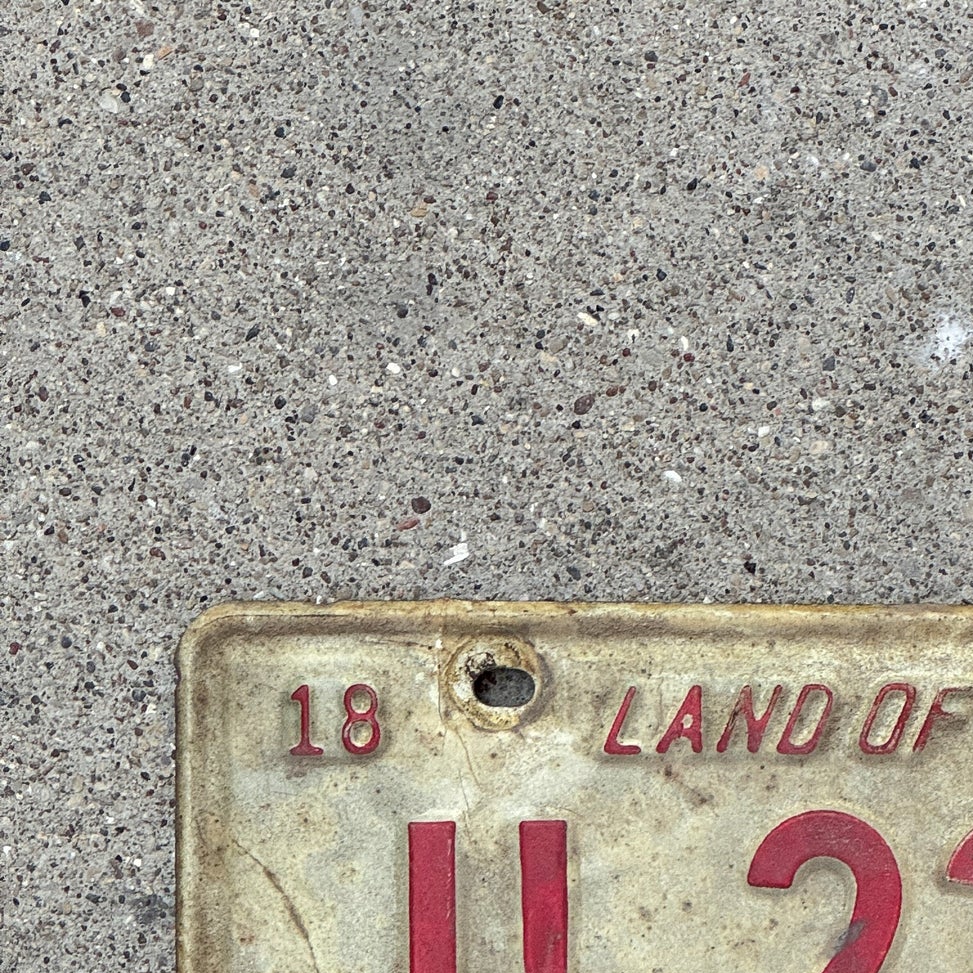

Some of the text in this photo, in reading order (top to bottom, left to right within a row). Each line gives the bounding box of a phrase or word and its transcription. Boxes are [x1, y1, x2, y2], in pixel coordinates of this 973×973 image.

[290, 684, 382, 758] 18
[602, 683, 835, 757] LAND
[858, 683, 972, 757] OF
